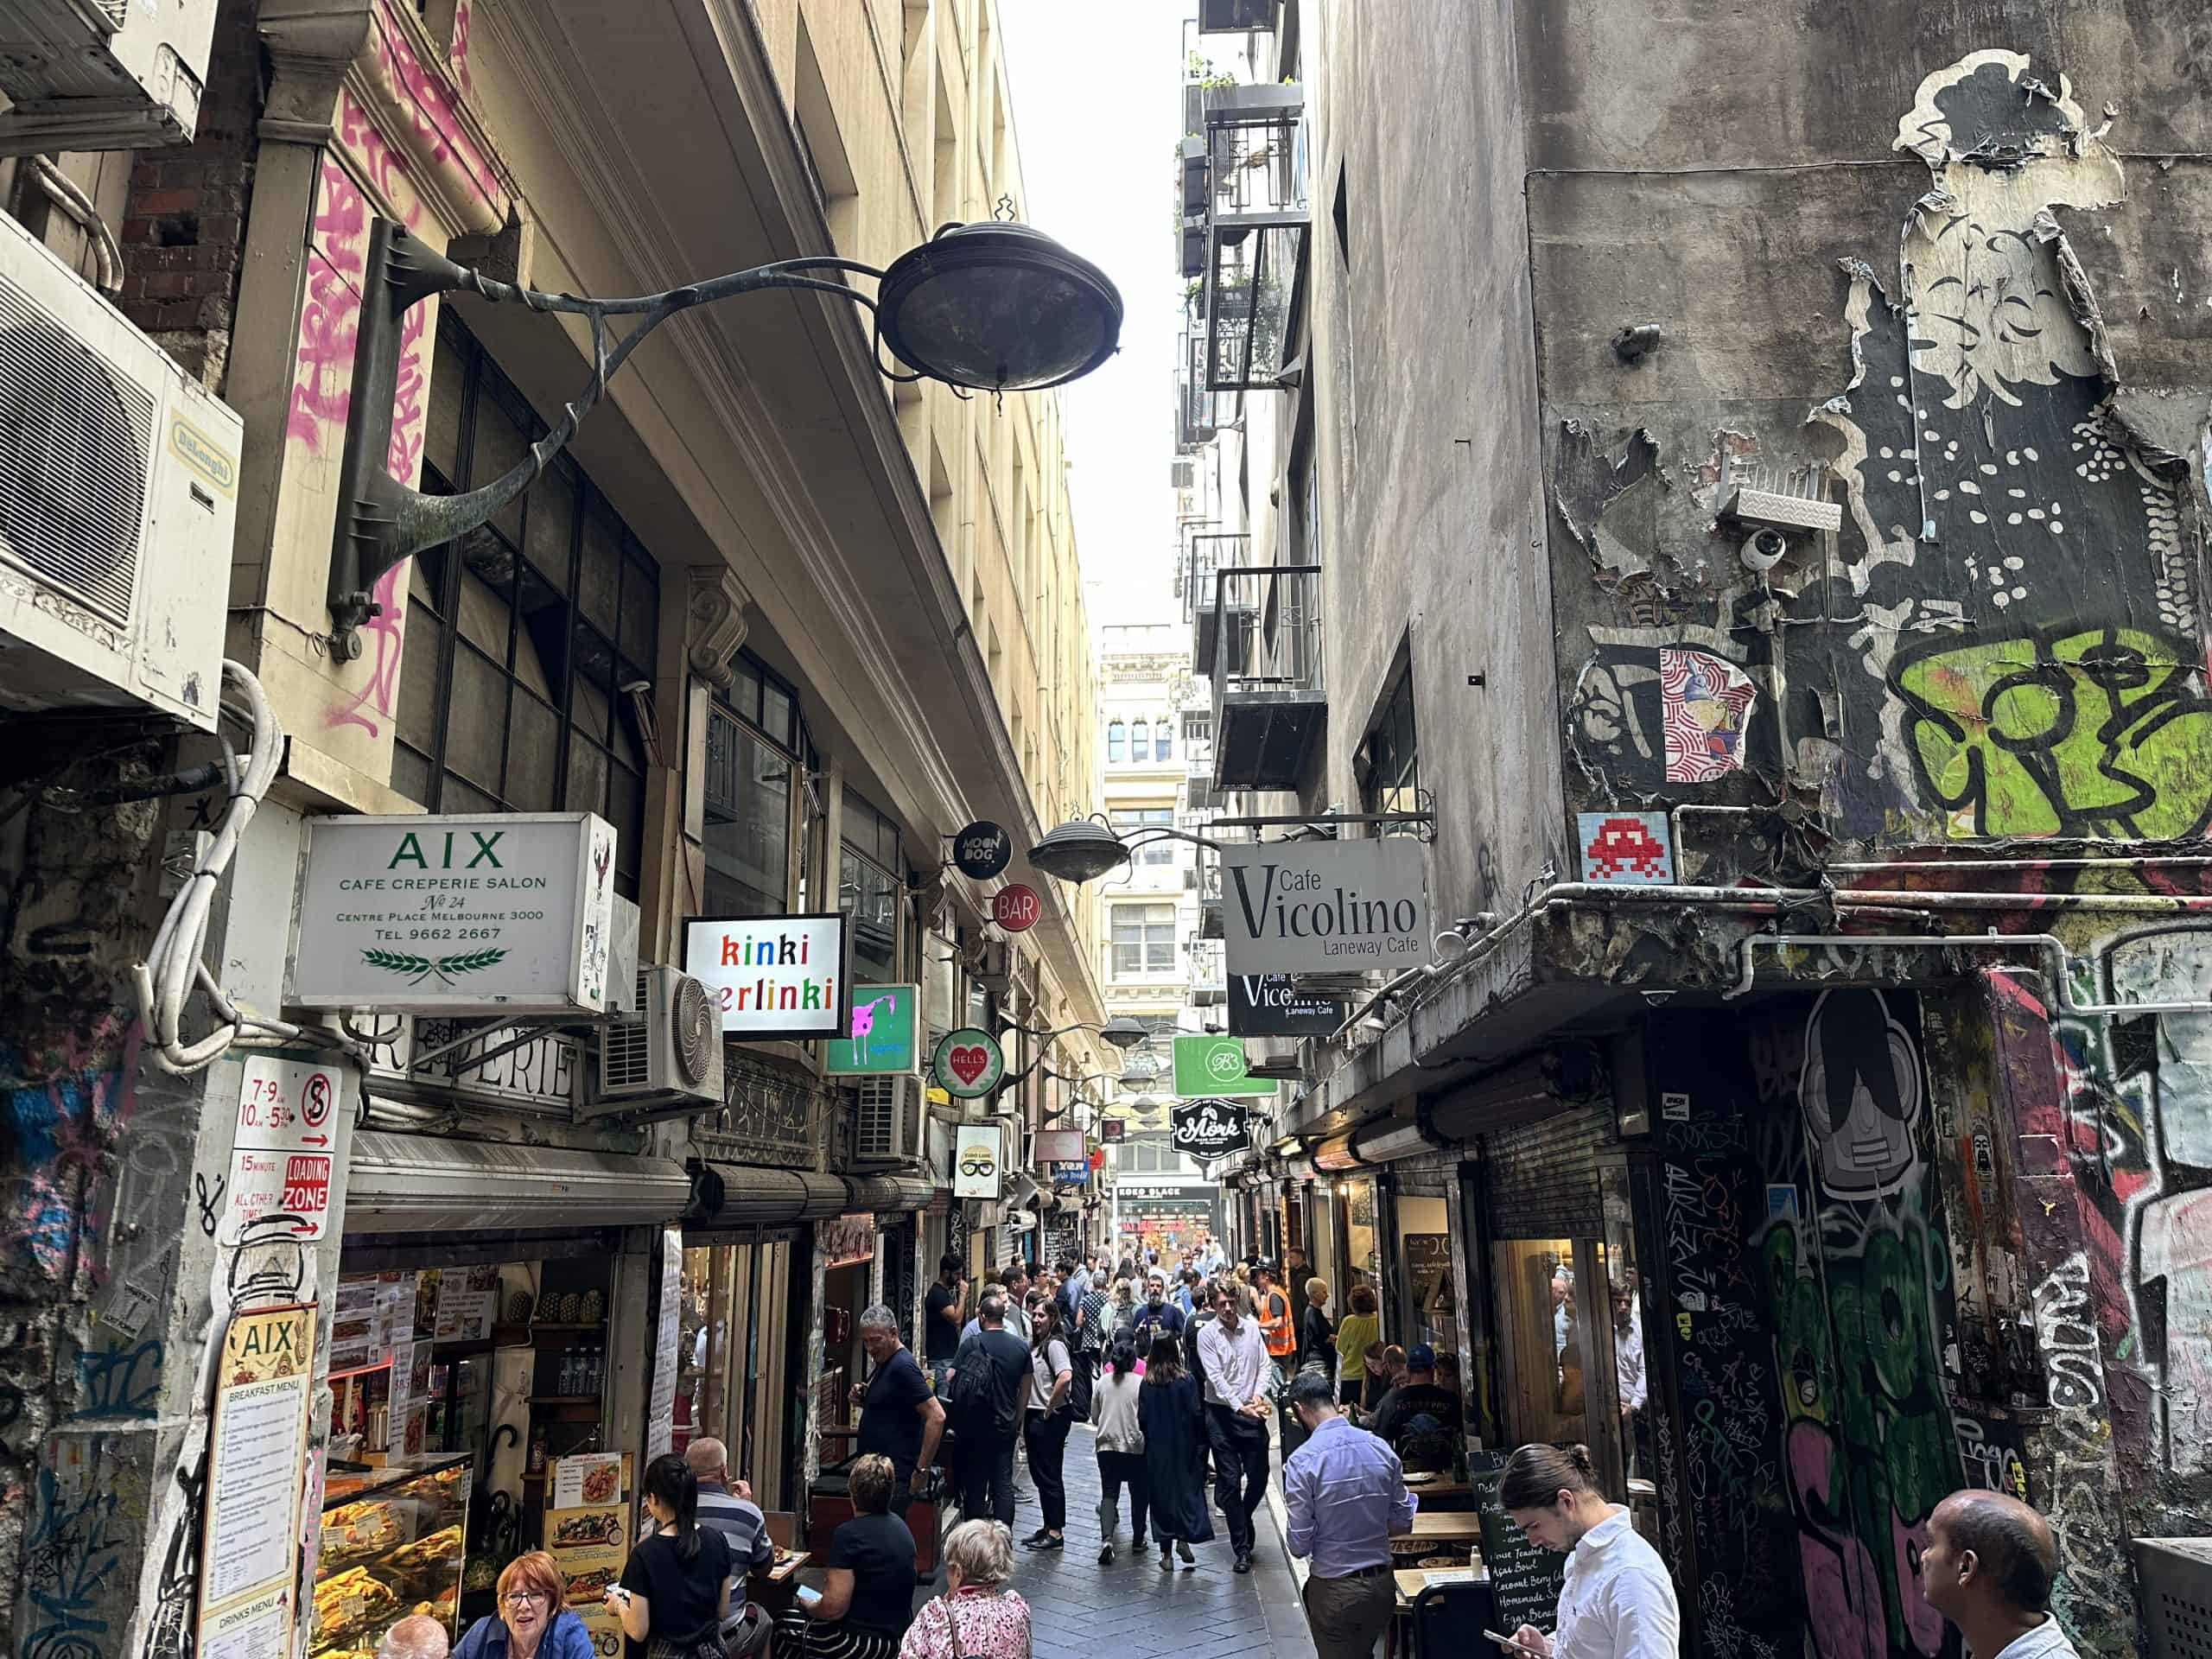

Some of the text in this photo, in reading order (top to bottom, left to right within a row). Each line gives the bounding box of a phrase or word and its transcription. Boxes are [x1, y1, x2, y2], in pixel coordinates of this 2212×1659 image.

[387, 830, 505, 870] AIX
[962, 830, 1003, 850] MOON
[339, 876, 547, 891] CAFE CREPERIE SALON
[1280, 869, 1321, 892] Cafe
[448, 895, 465, 910] 24
[999, 894, 1034, 921] BAR
[1228, 864, 1417, 938] Vicolino
[510, 911, 544, 920] 3000
[410, 928, 451, 940] 9662
[458, 927, 501, 939] 2667
[721, 933, 810, 966] kinki
[1323, 937, 1419, 957] Laneway Cafe
[721, 976, 834, 1013] erlinki
[1287, 1007, 1316, 1016] Laneway
[1178, 1116, 1241, 1143] Mörk
[241, 1154, 253, 1172] 15
[288, 1159, 329, 1181] LOADING
[283, 1186, 327, 1209] ZONE
[241, 1319, 295, 1357] AIX
[227, 1380, 300, 1402] BREAKFAST MENU
[1514, 1558, 1539, 1573] Bowl
[1495, 1577, 1529, 1592] Coconut
[1499, 1591, 1545, 1609] Homemade
[219, 1597, 275, 1629] DRINKS MENU
